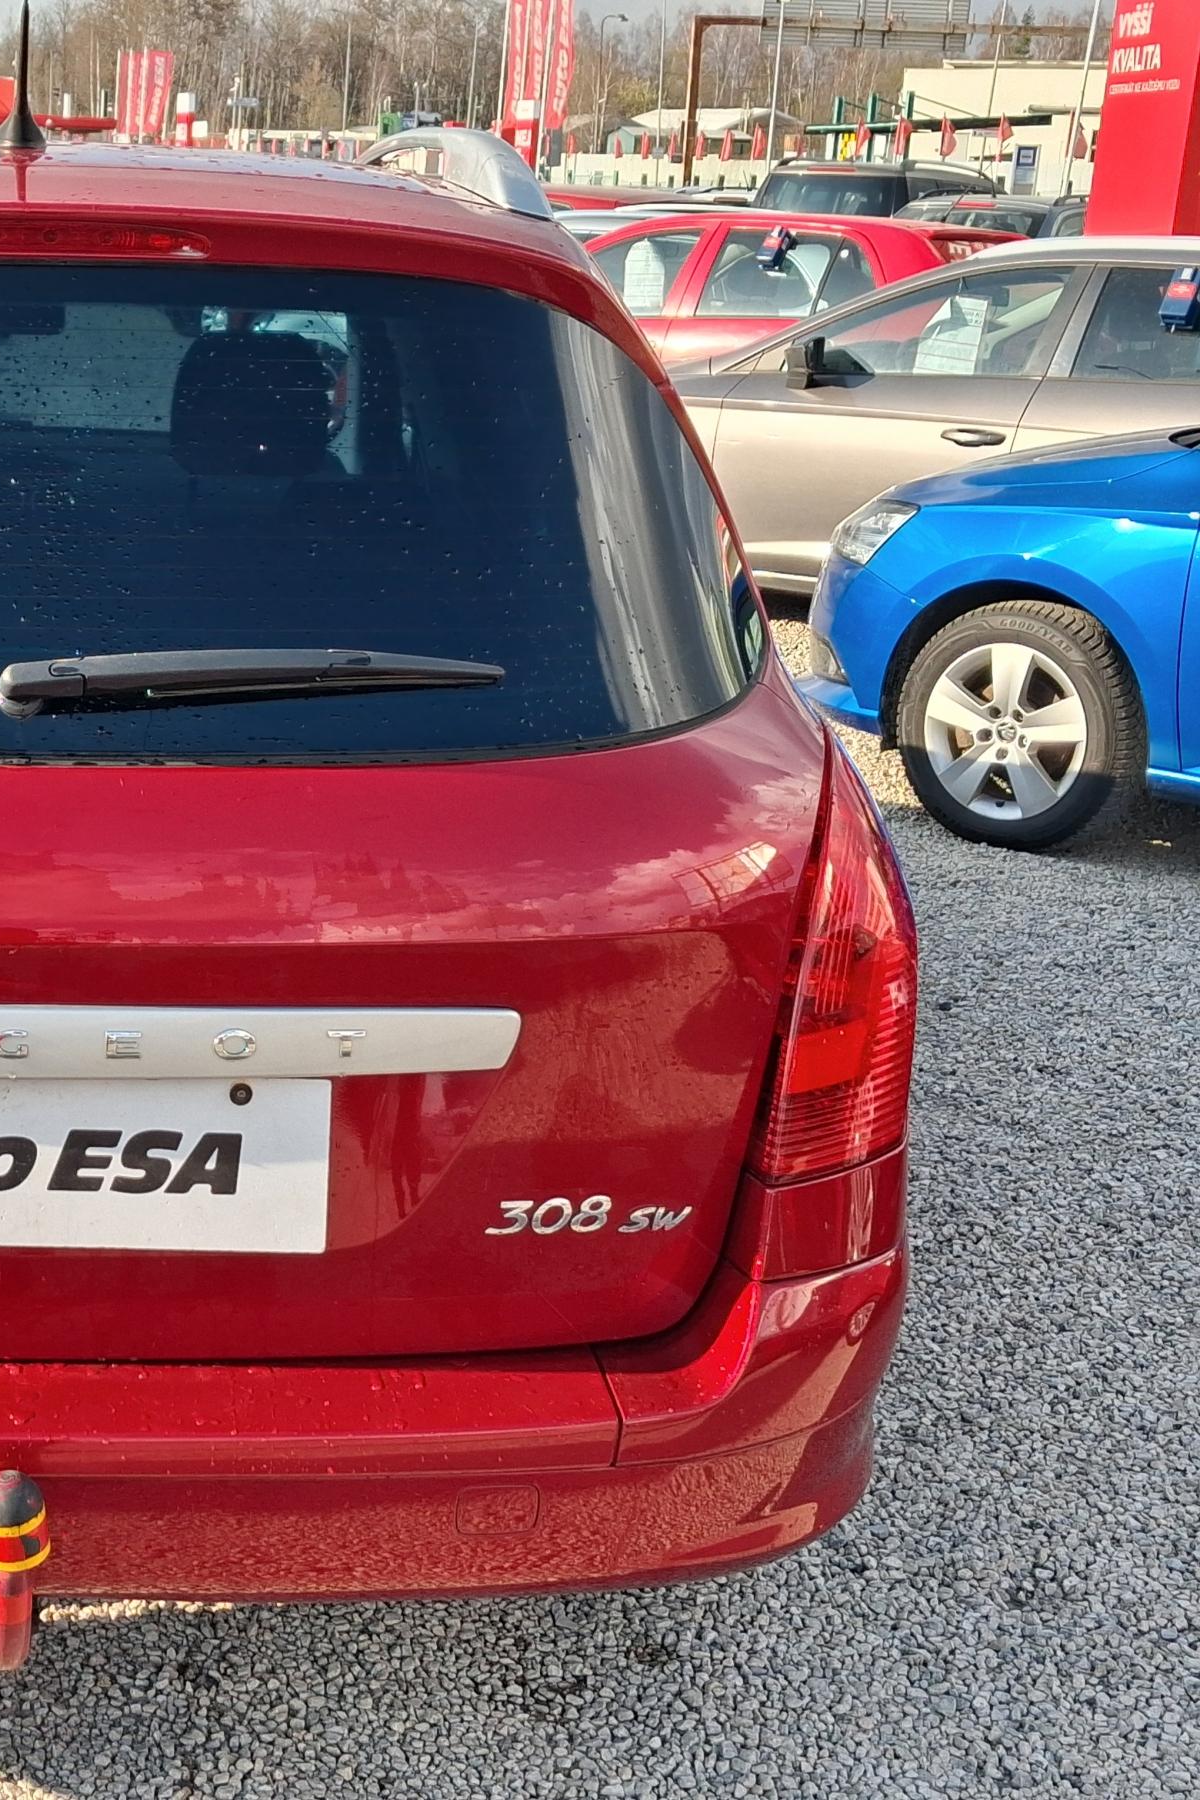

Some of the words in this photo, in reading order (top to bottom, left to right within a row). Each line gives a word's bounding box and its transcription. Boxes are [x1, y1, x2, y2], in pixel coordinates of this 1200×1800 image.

[1119, 2, 1155, 38] VYŠŠÍ
[1111, 44, 1161, 74] KVALITA
[47, 1129, 242, 1195] ESA
[485, 1195, 612, 1235] 308
